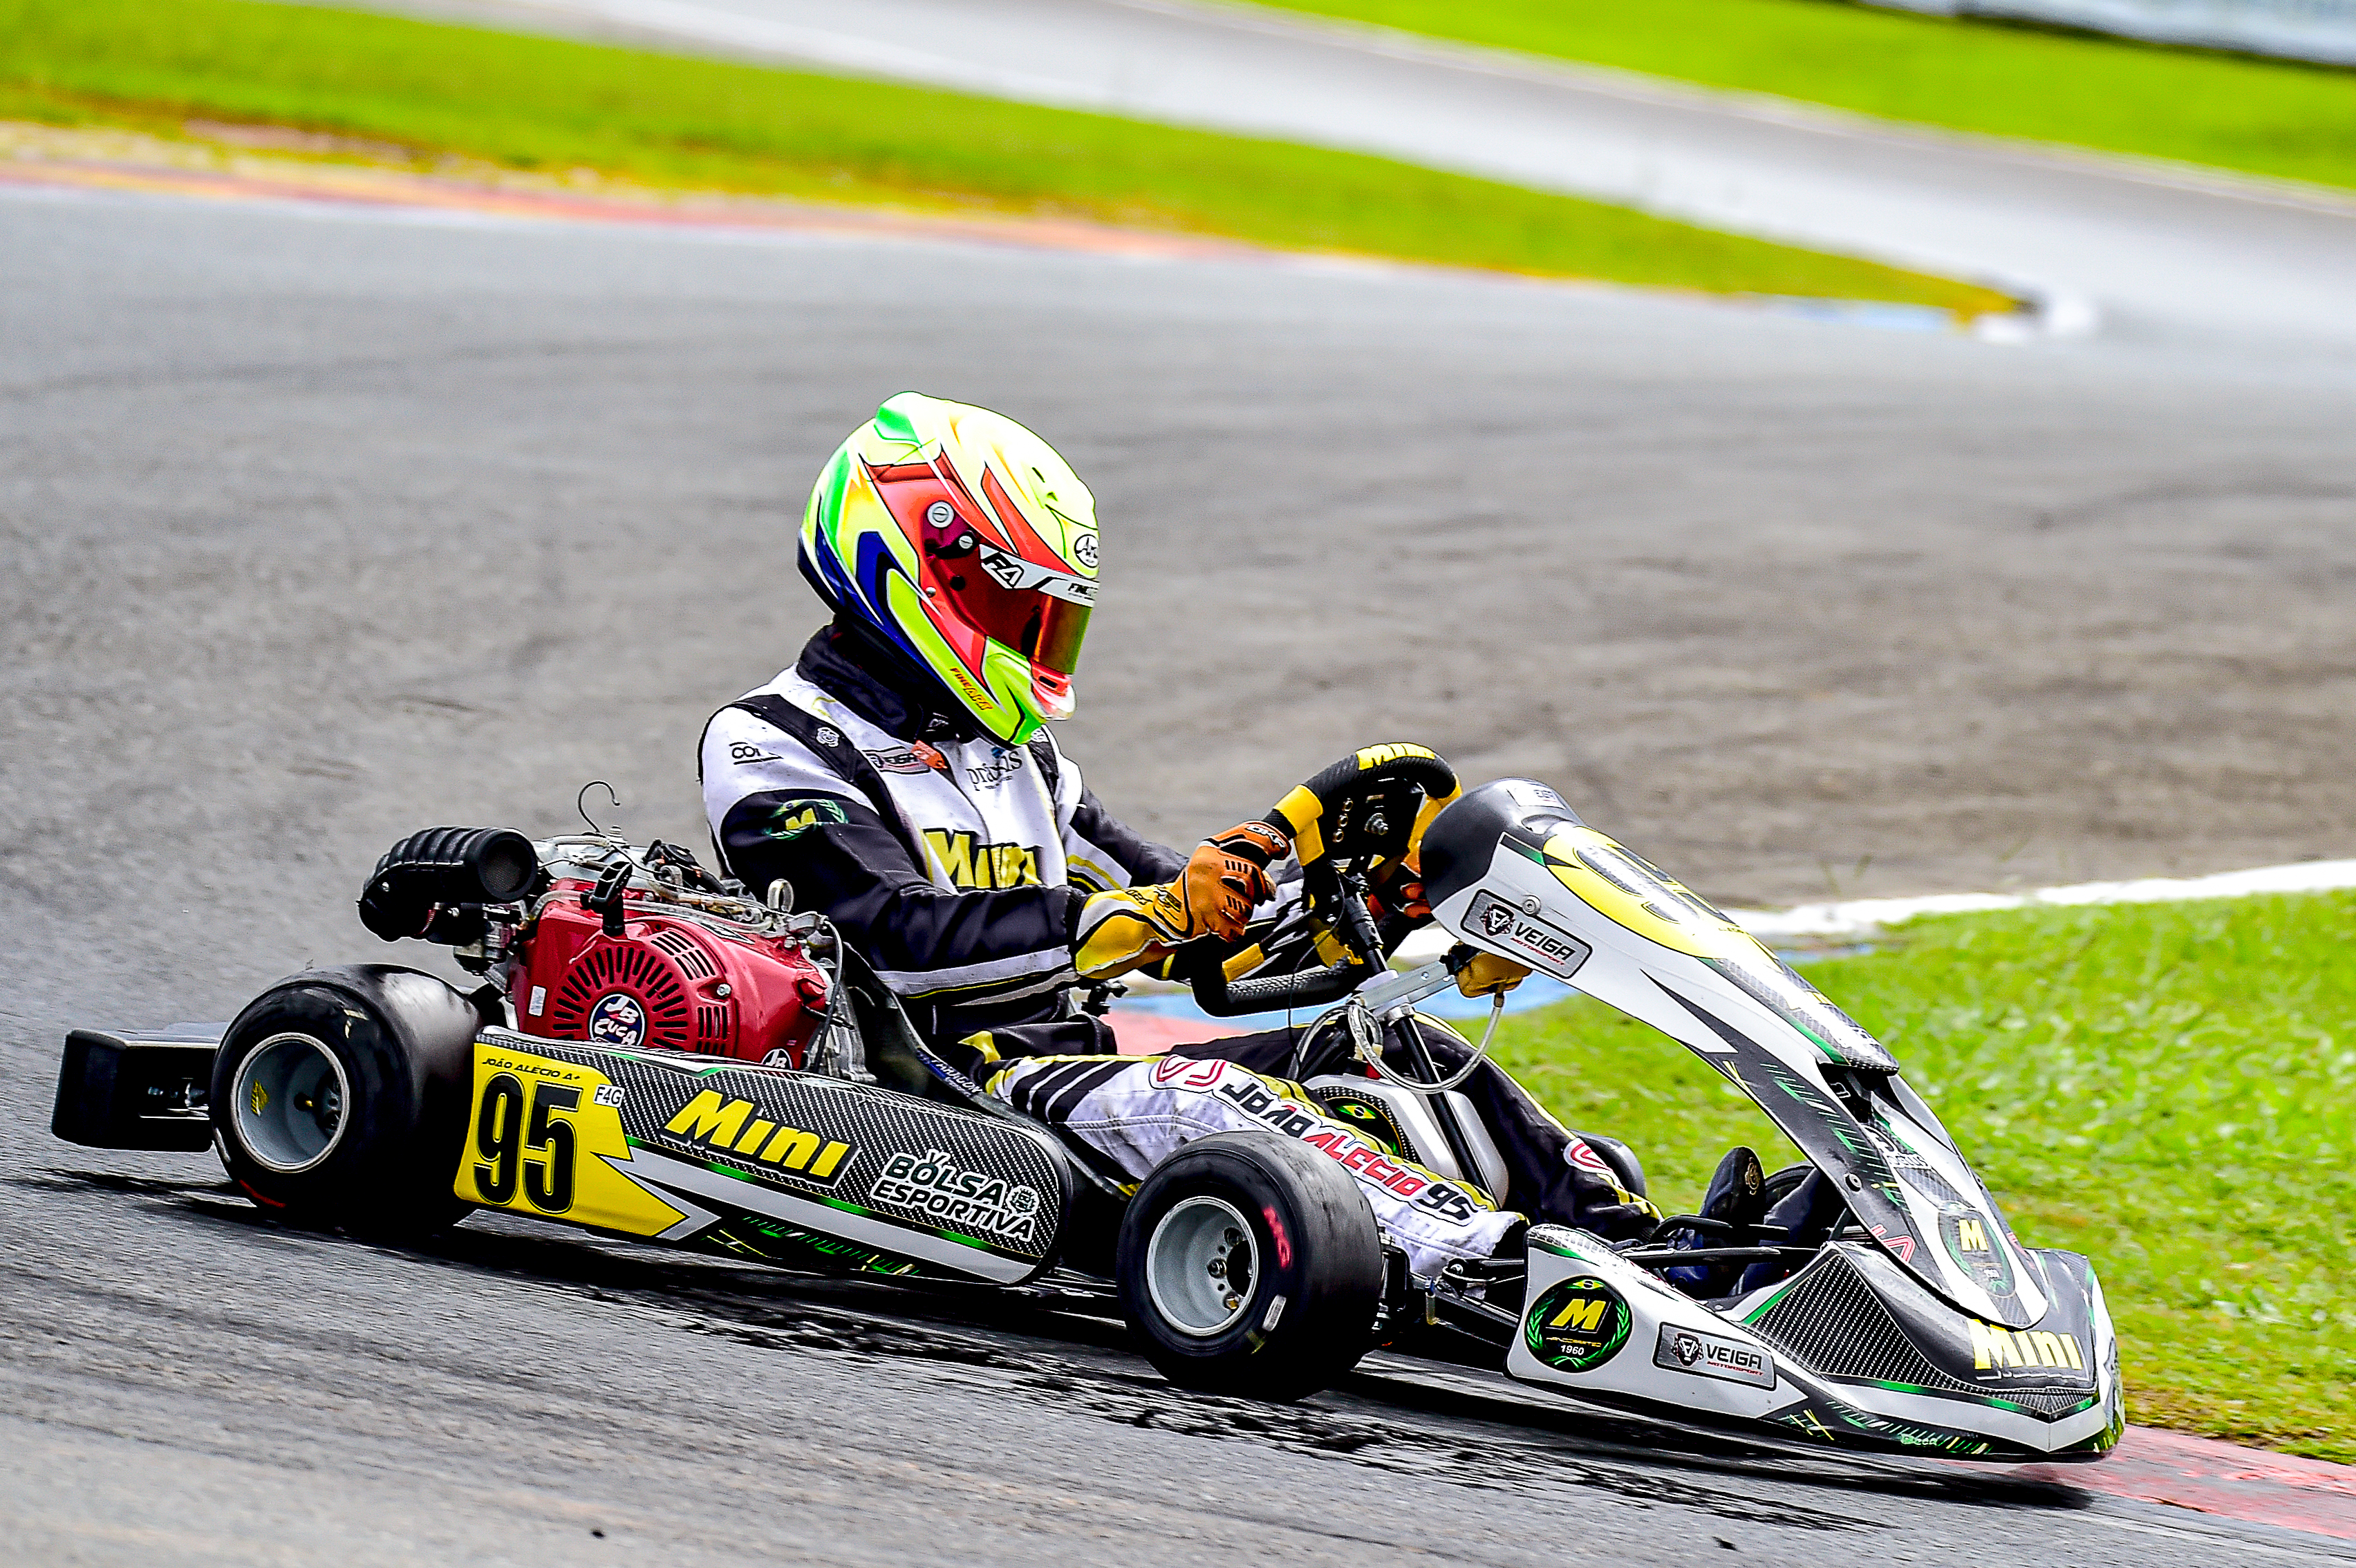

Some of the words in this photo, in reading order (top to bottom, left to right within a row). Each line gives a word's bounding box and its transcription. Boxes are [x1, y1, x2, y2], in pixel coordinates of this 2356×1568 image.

[1515, 922, 1576, 961] VEIGA
[604, 996, 639, 1025] JB
[482, 1058, 512, 1070] JOÃO
[595, 1086, 623, 1105] F4G
[474, 1072, 583, 1215] 95
[884, 1152, 1004, 1207] BOLSA
[872, 1179, 1034, 1240] ESPORTIVA
[1959, 1218, 1989, 1251] M
[1549, 1298, 1607, 1329] M
[1560, 1345, 1584, 1356] 1960
[1706, 1343, 1762, 1370] VEIGA
